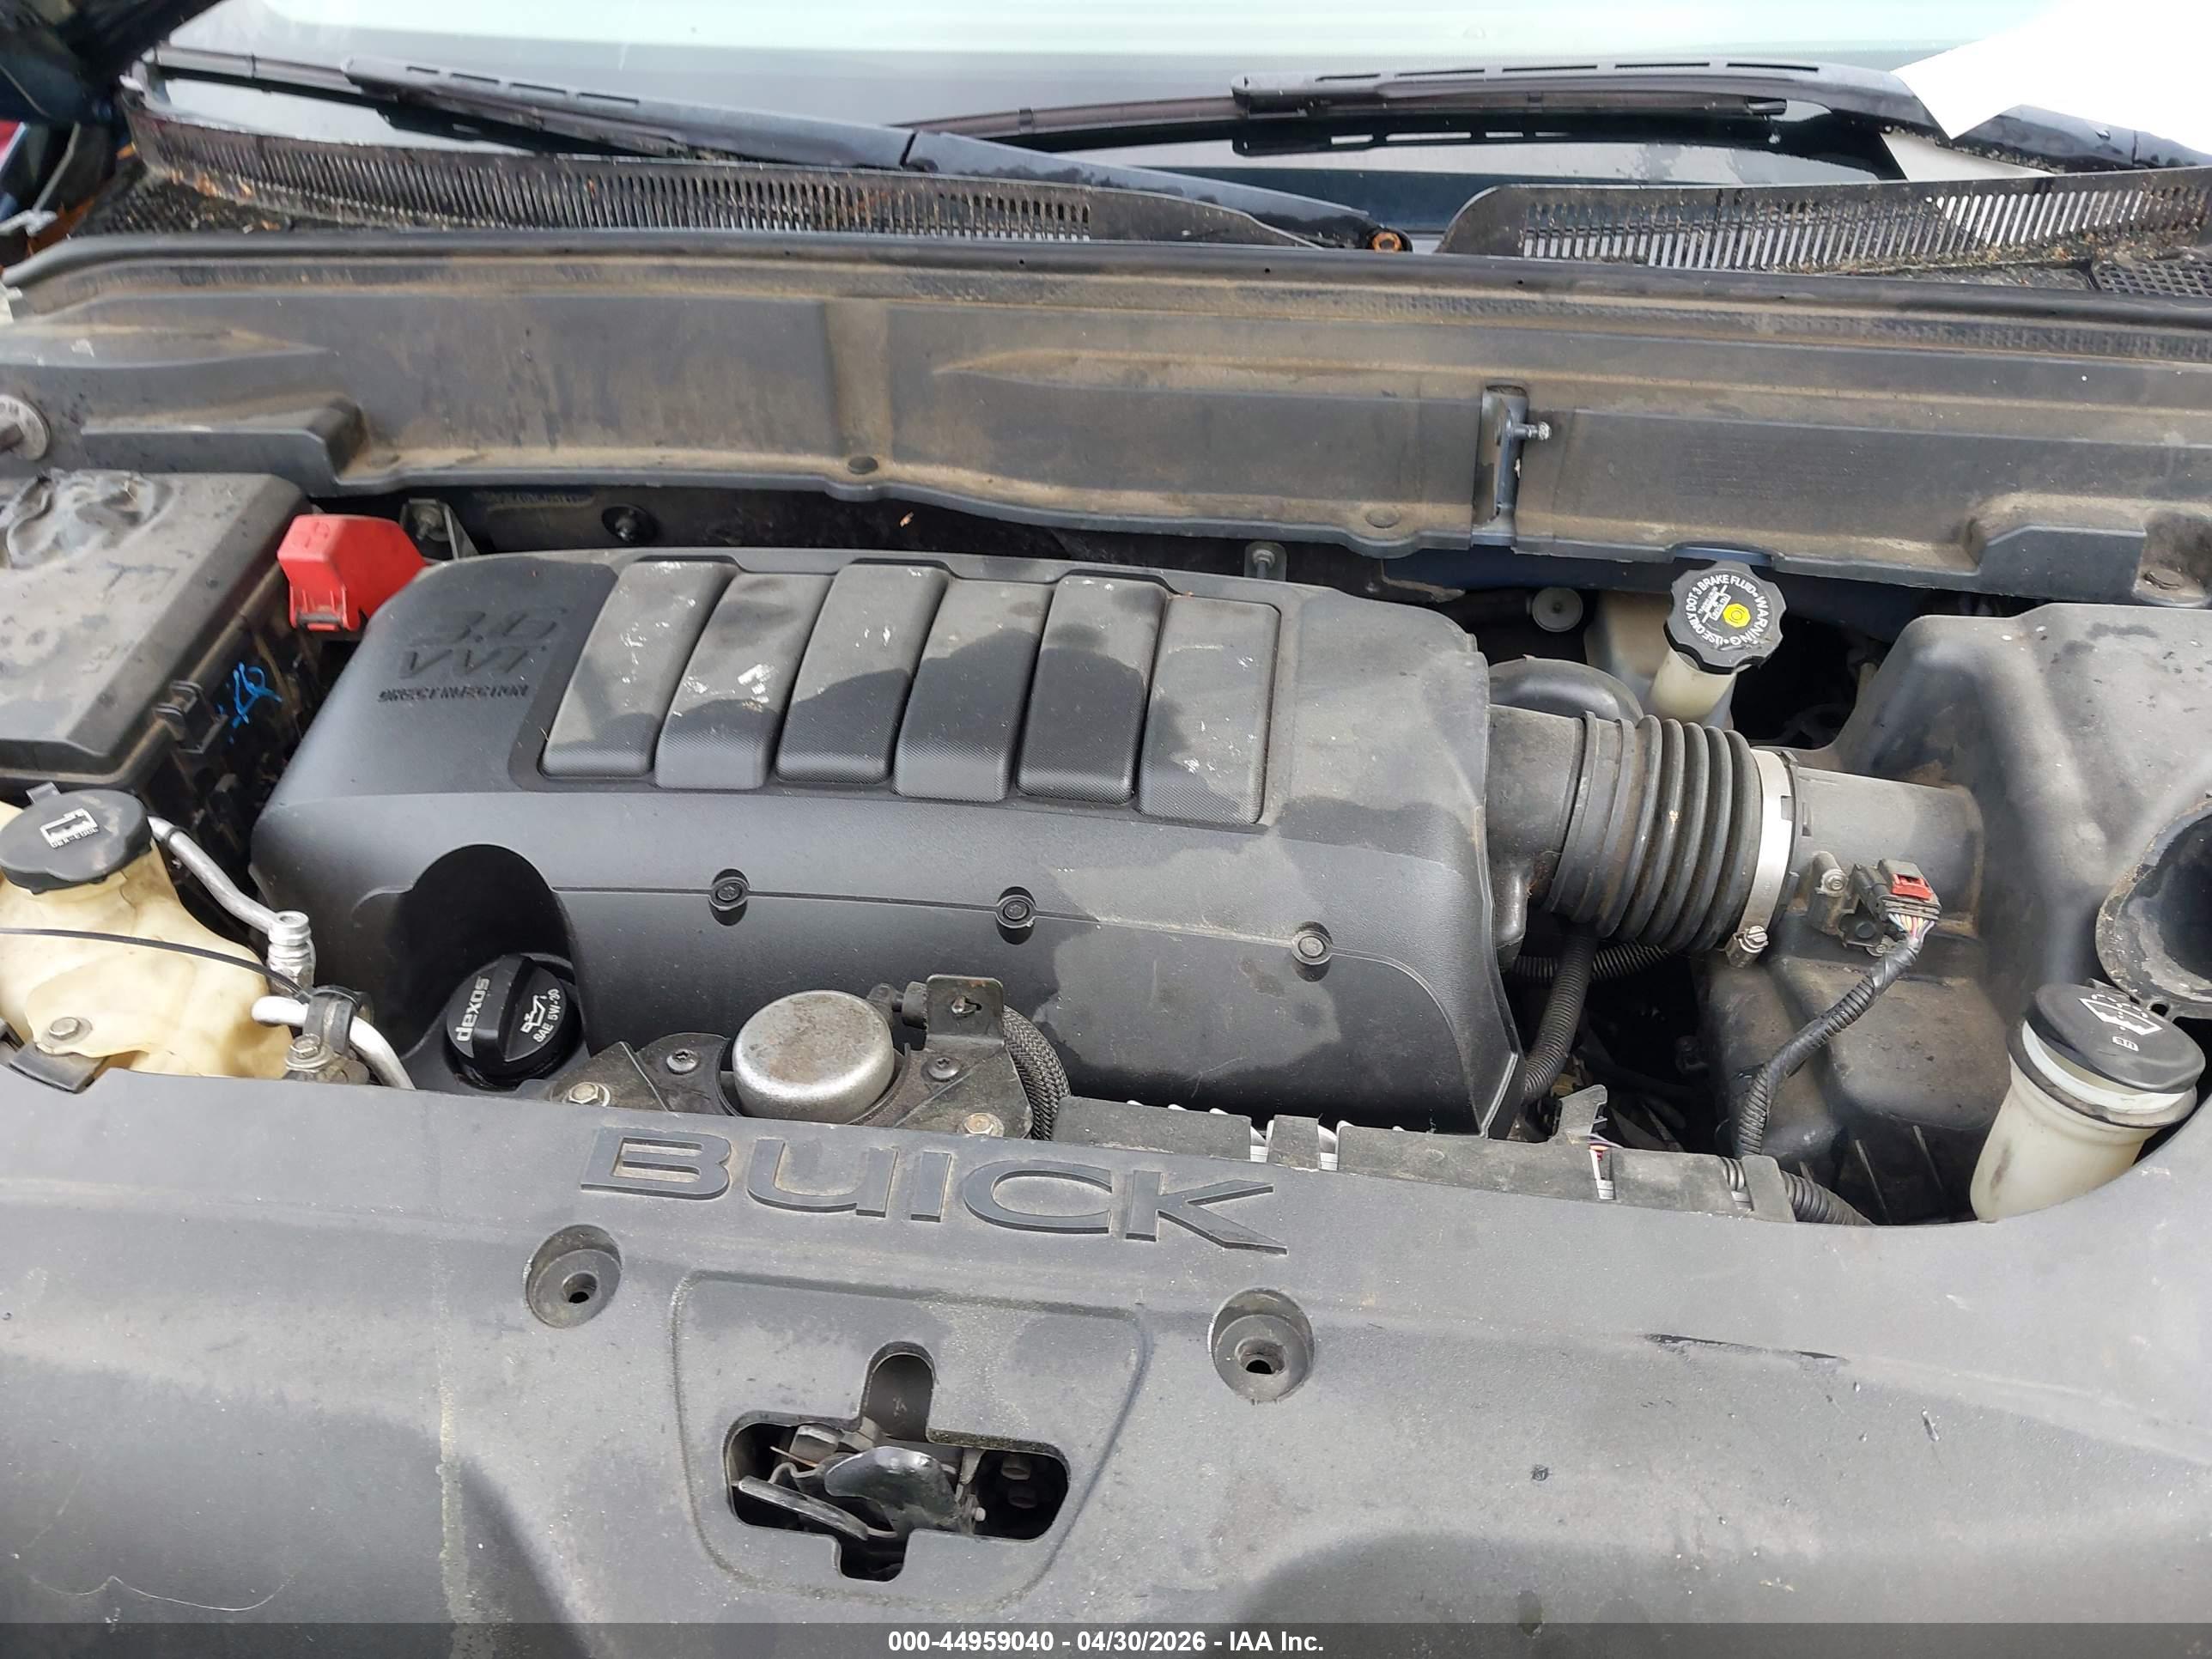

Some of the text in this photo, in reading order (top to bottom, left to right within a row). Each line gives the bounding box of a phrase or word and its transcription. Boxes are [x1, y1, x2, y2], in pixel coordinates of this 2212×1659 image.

[1692, 586, 1702, 595] 3
[1697, 574, 1729, 591] BRAKE
[1730, 575, 1757, 594] FLUID
[1686, 592, 1698, 611] DOT
[1686, 612, 1705, 635] ONLY
[1701, 629, 1723, 646] USE
[455, 975, 489, 1042] dexos
[532, 1022, 555, 1042] SAE
[580, 1126, 1287, 1255] BUICK
